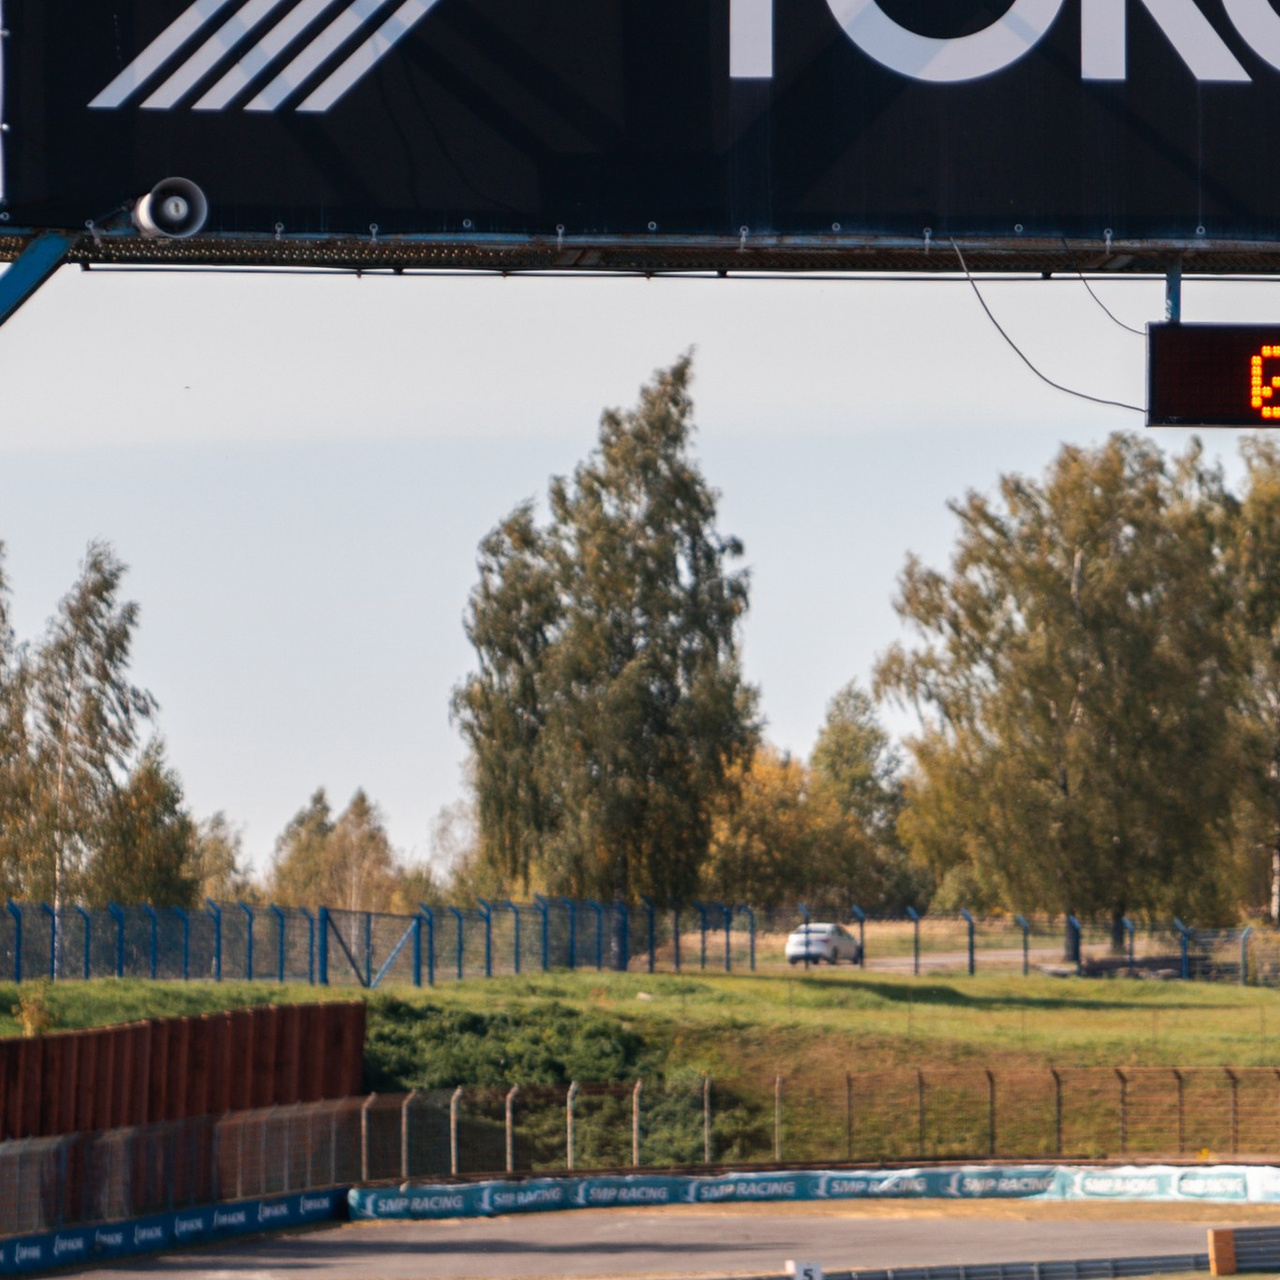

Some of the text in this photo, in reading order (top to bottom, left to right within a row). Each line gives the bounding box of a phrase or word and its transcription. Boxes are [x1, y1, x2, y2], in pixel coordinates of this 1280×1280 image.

[700, 1180, 796, 1199] SMP RACING
[830, 1179, 866, 1193] SMP
[962, 1177, 997, 1191] SMP
[589, 1185, 669, 1200] SMP RACING
[377, 1194, 463, 1212] SMP RACING
